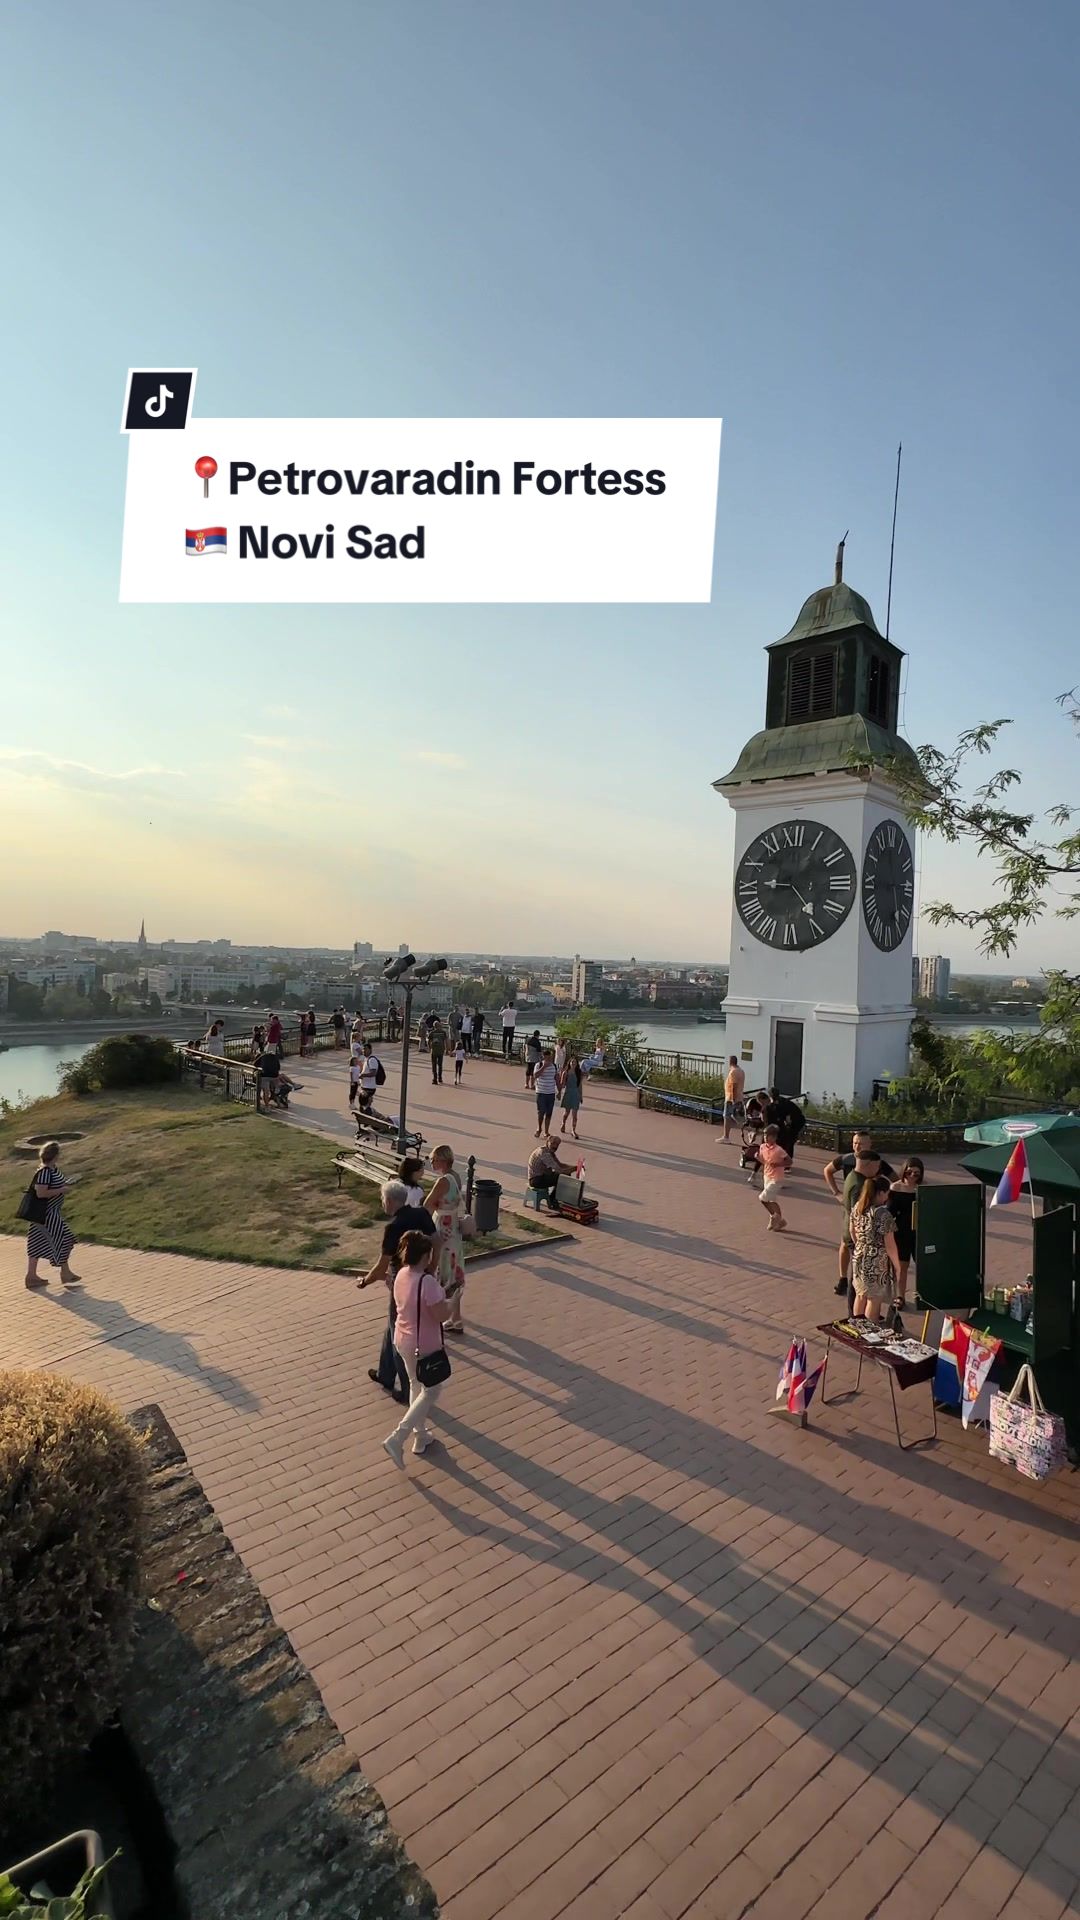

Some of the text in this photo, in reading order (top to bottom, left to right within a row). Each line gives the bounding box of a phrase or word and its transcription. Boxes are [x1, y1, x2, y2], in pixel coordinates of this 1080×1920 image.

[760, 832, 780, 857] XI
[783, 825, 805, 848] XII
[810, 830, 824, 851] I
[744, 855, 764, 872] X
[823, 847, 846, 867] II
[739, 879, 758, 896] IX
[829, 874, 851, 890] III
[741, 897, 764, 927] VIII
[823, 899, 846, 921] IV
[756, 915, 777, 941] VII
[783, 923, 798, 945] VI
[809, 918, 825, 940] V
